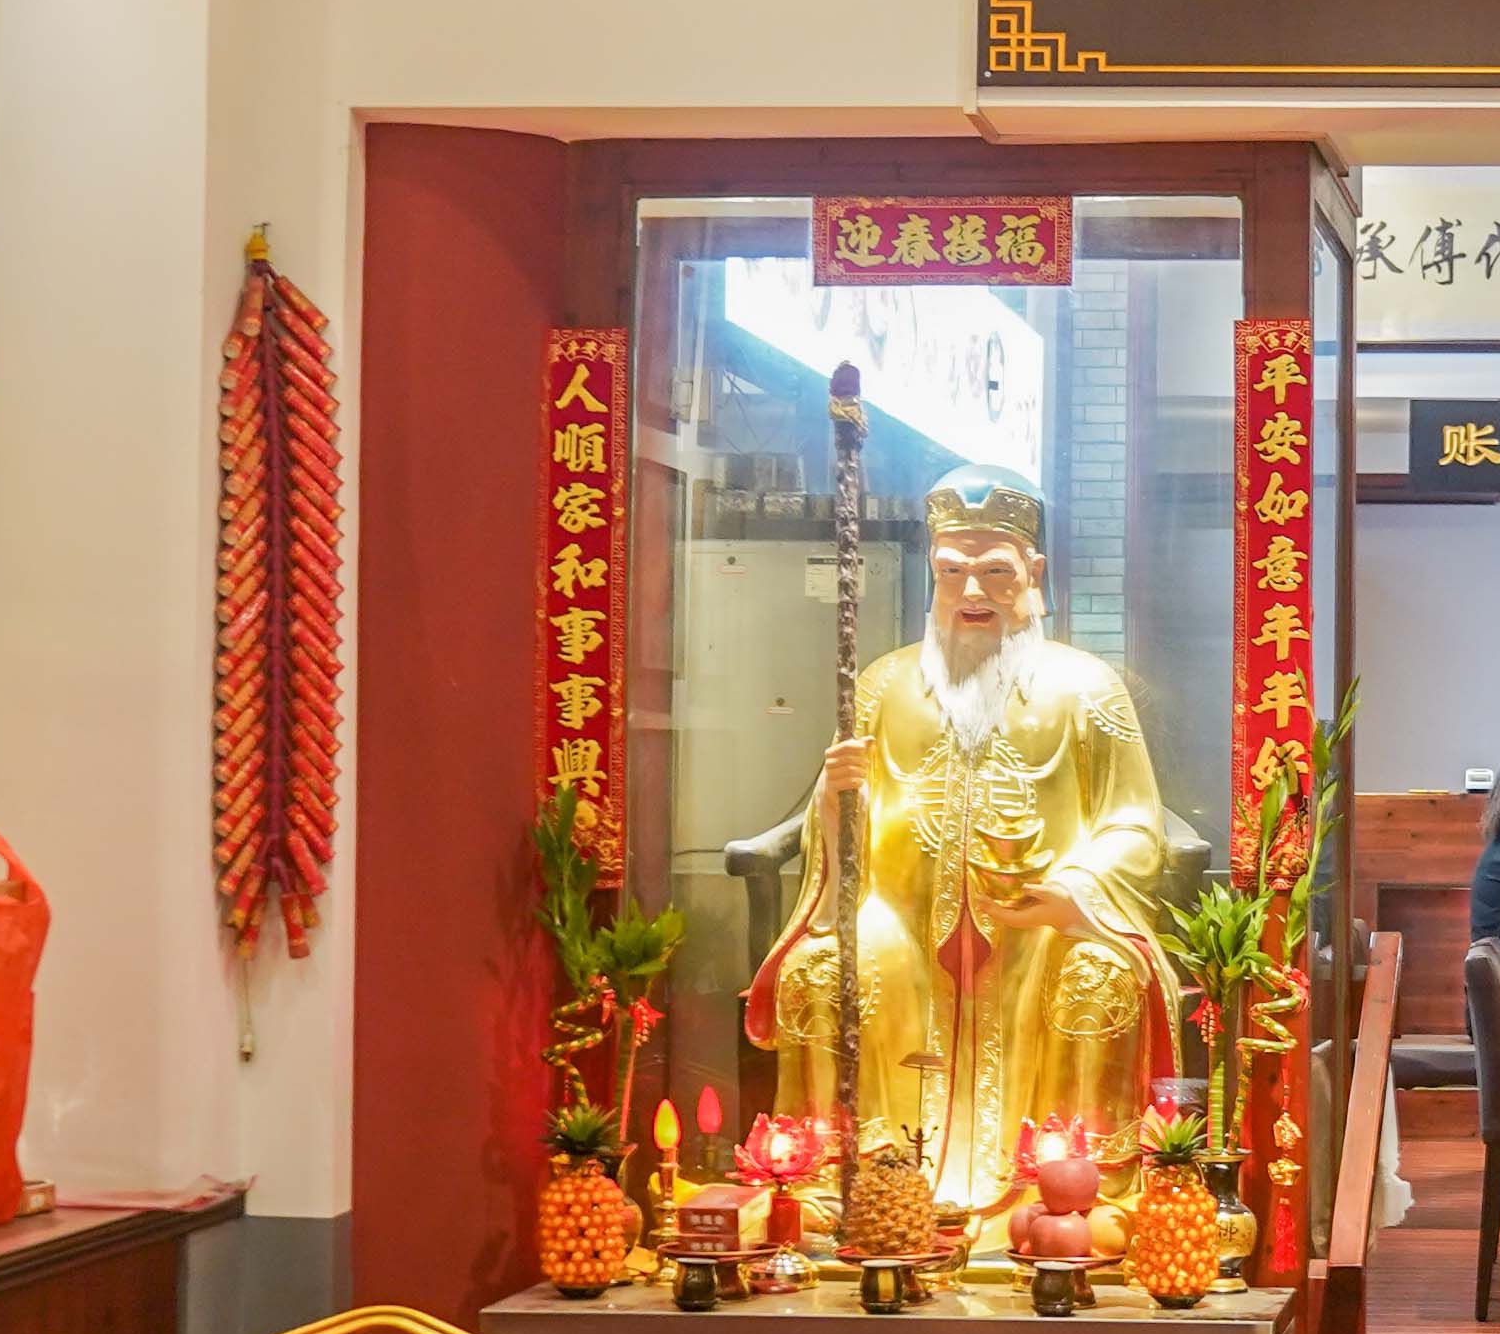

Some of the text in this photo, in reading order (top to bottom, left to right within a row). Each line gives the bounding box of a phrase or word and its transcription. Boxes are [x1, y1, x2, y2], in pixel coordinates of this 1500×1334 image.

[833, 214, 1048, 268] 迎春接福
[1251, 352, 1310, 795] 平安如意年年好
